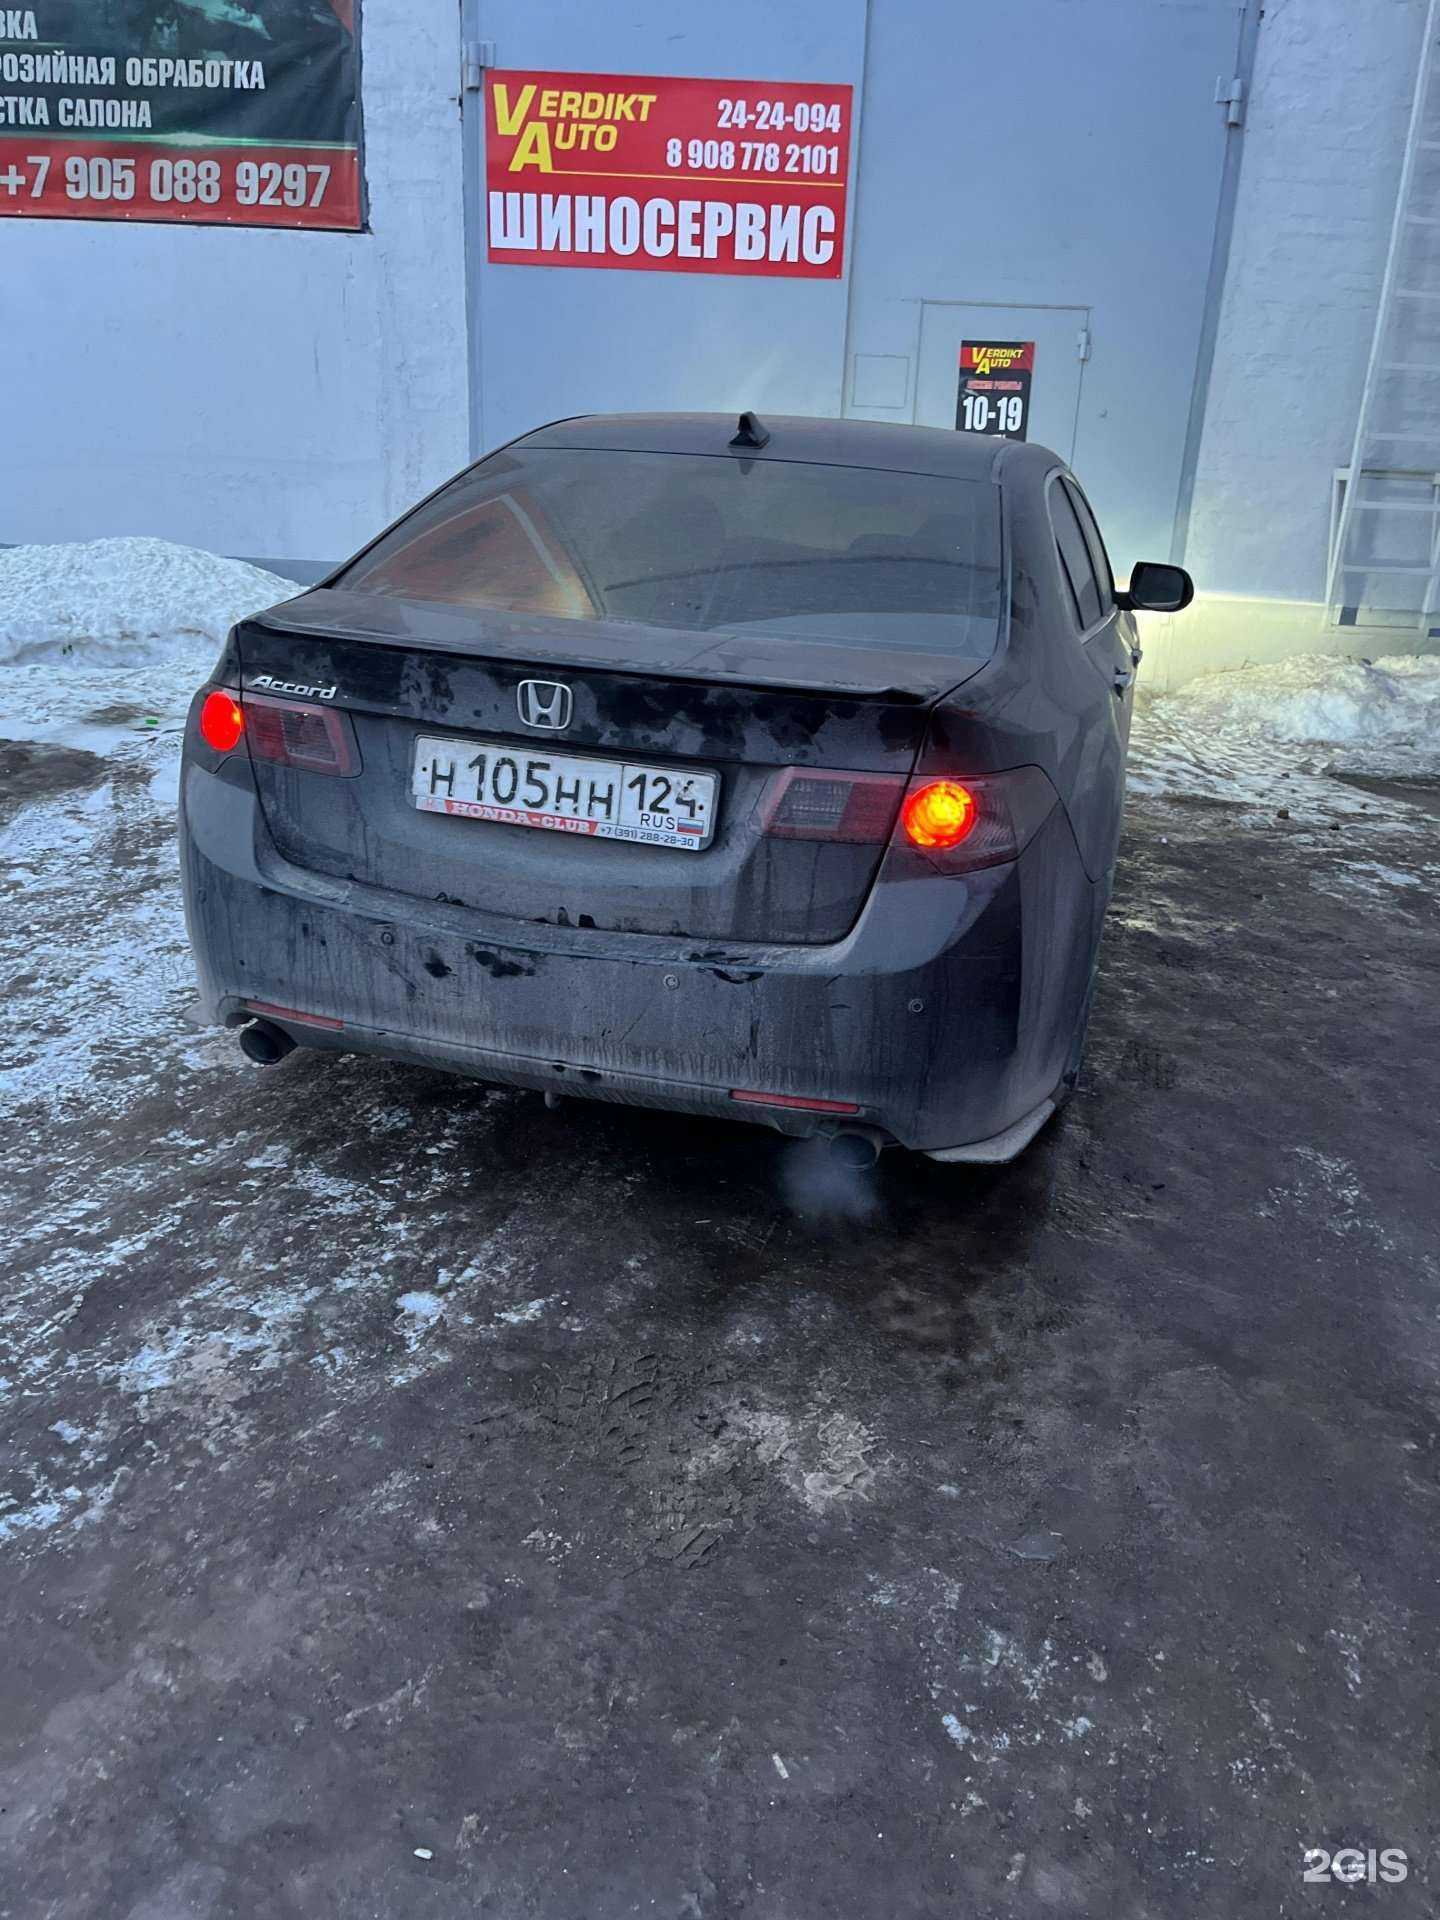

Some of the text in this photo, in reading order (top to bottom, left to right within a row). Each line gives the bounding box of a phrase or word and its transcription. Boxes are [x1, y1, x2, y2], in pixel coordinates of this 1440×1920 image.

[0, 50, 265, 90] ОЗИЙНАЯ ОБРАБОТКА
[58, 98, 152, 128] САЛОНА
[493, 84, 656, 136] VERDIKT
[717, 99, 841, 134] 24-24-094
[508, 121, 617, 173] AUTO
[666, 138, 839, 175] 8 908 778 2101
[0, 156, 331, 208] +7 905 088 9297
[489, 191, 835, 265] ШИНОСЕРВИС
[971, 346, 1025, 364] VERDIKT
[975, 358, 1012, 375] AUTO
[962, 395, 1023, 432] 10-19
[250, 674, 337, 700] Accord
[450, 801, 591, 834] HONDA-CLUB
[640, 812, 676, 830] RUS
